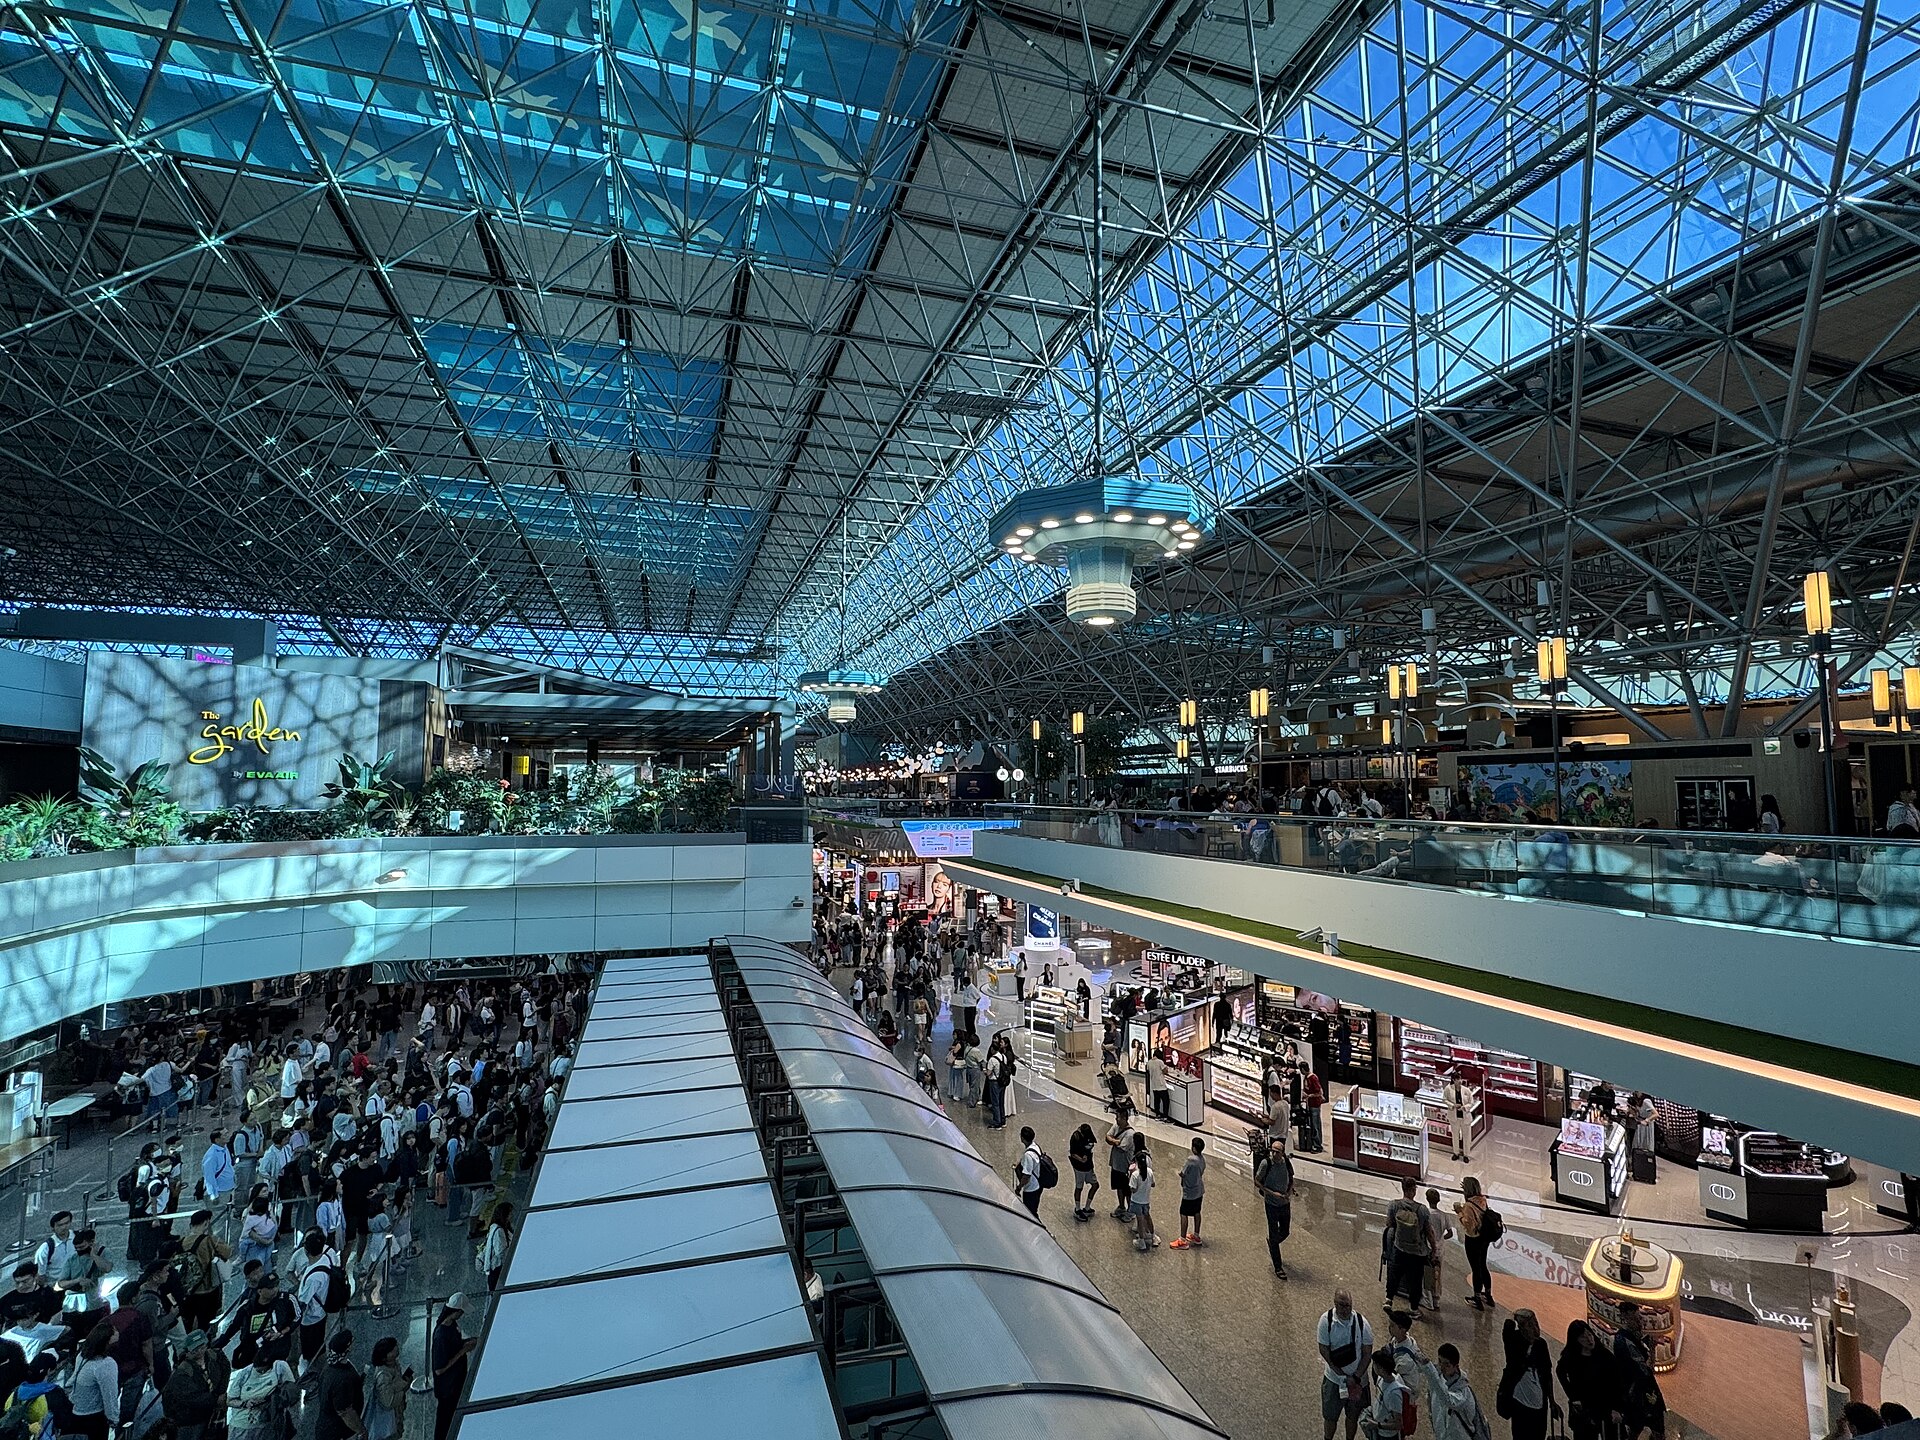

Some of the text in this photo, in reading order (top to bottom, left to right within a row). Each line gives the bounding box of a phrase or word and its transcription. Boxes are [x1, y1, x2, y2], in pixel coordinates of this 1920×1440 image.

[201, 711, 220, 720] The
[187, 697, 302, 765] garden
[1214, 765, 1248, 774] STARBUCKS
[1171, 954, 1206, 967] LAUDER
